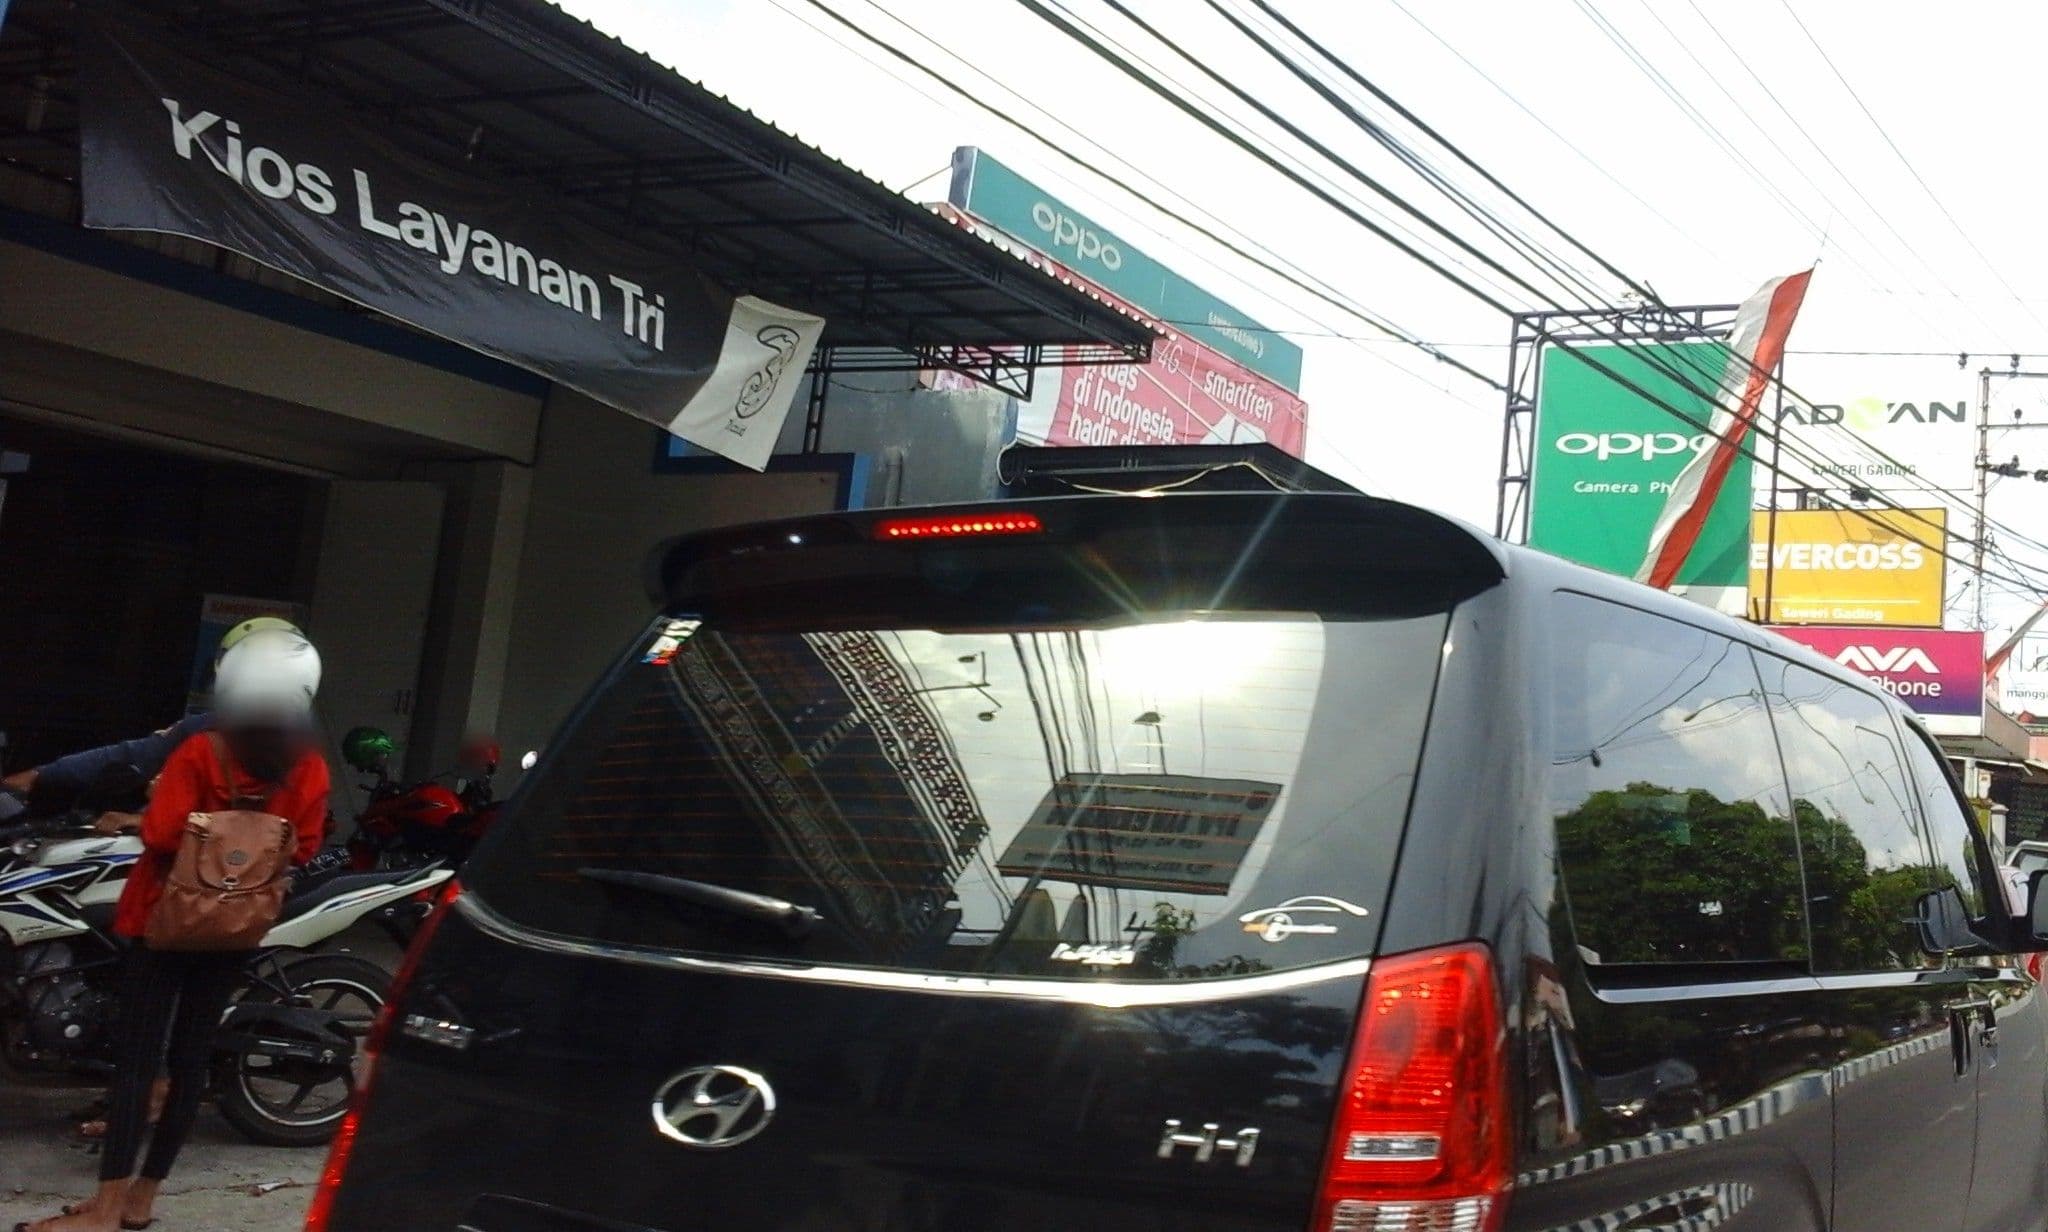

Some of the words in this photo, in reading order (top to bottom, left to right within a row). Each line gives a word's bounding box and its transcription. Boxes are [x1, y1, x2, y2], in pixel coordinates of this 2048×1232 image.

[161, 97, 337, 214] Kios
[353, 168, 601, 321] Layanan
[609, 273, 665, 351] Tri
[1033, 202, 1122, 271] oppo
[1203, 369, 1274, 424] smartfren
[1573, 481, 1640, 494] Camera
[1750, 543, 1924, 570] EVERCOSS
[1835, 645, 1941, 674] AVA
[2006, 689, 2048, 701] mangg
